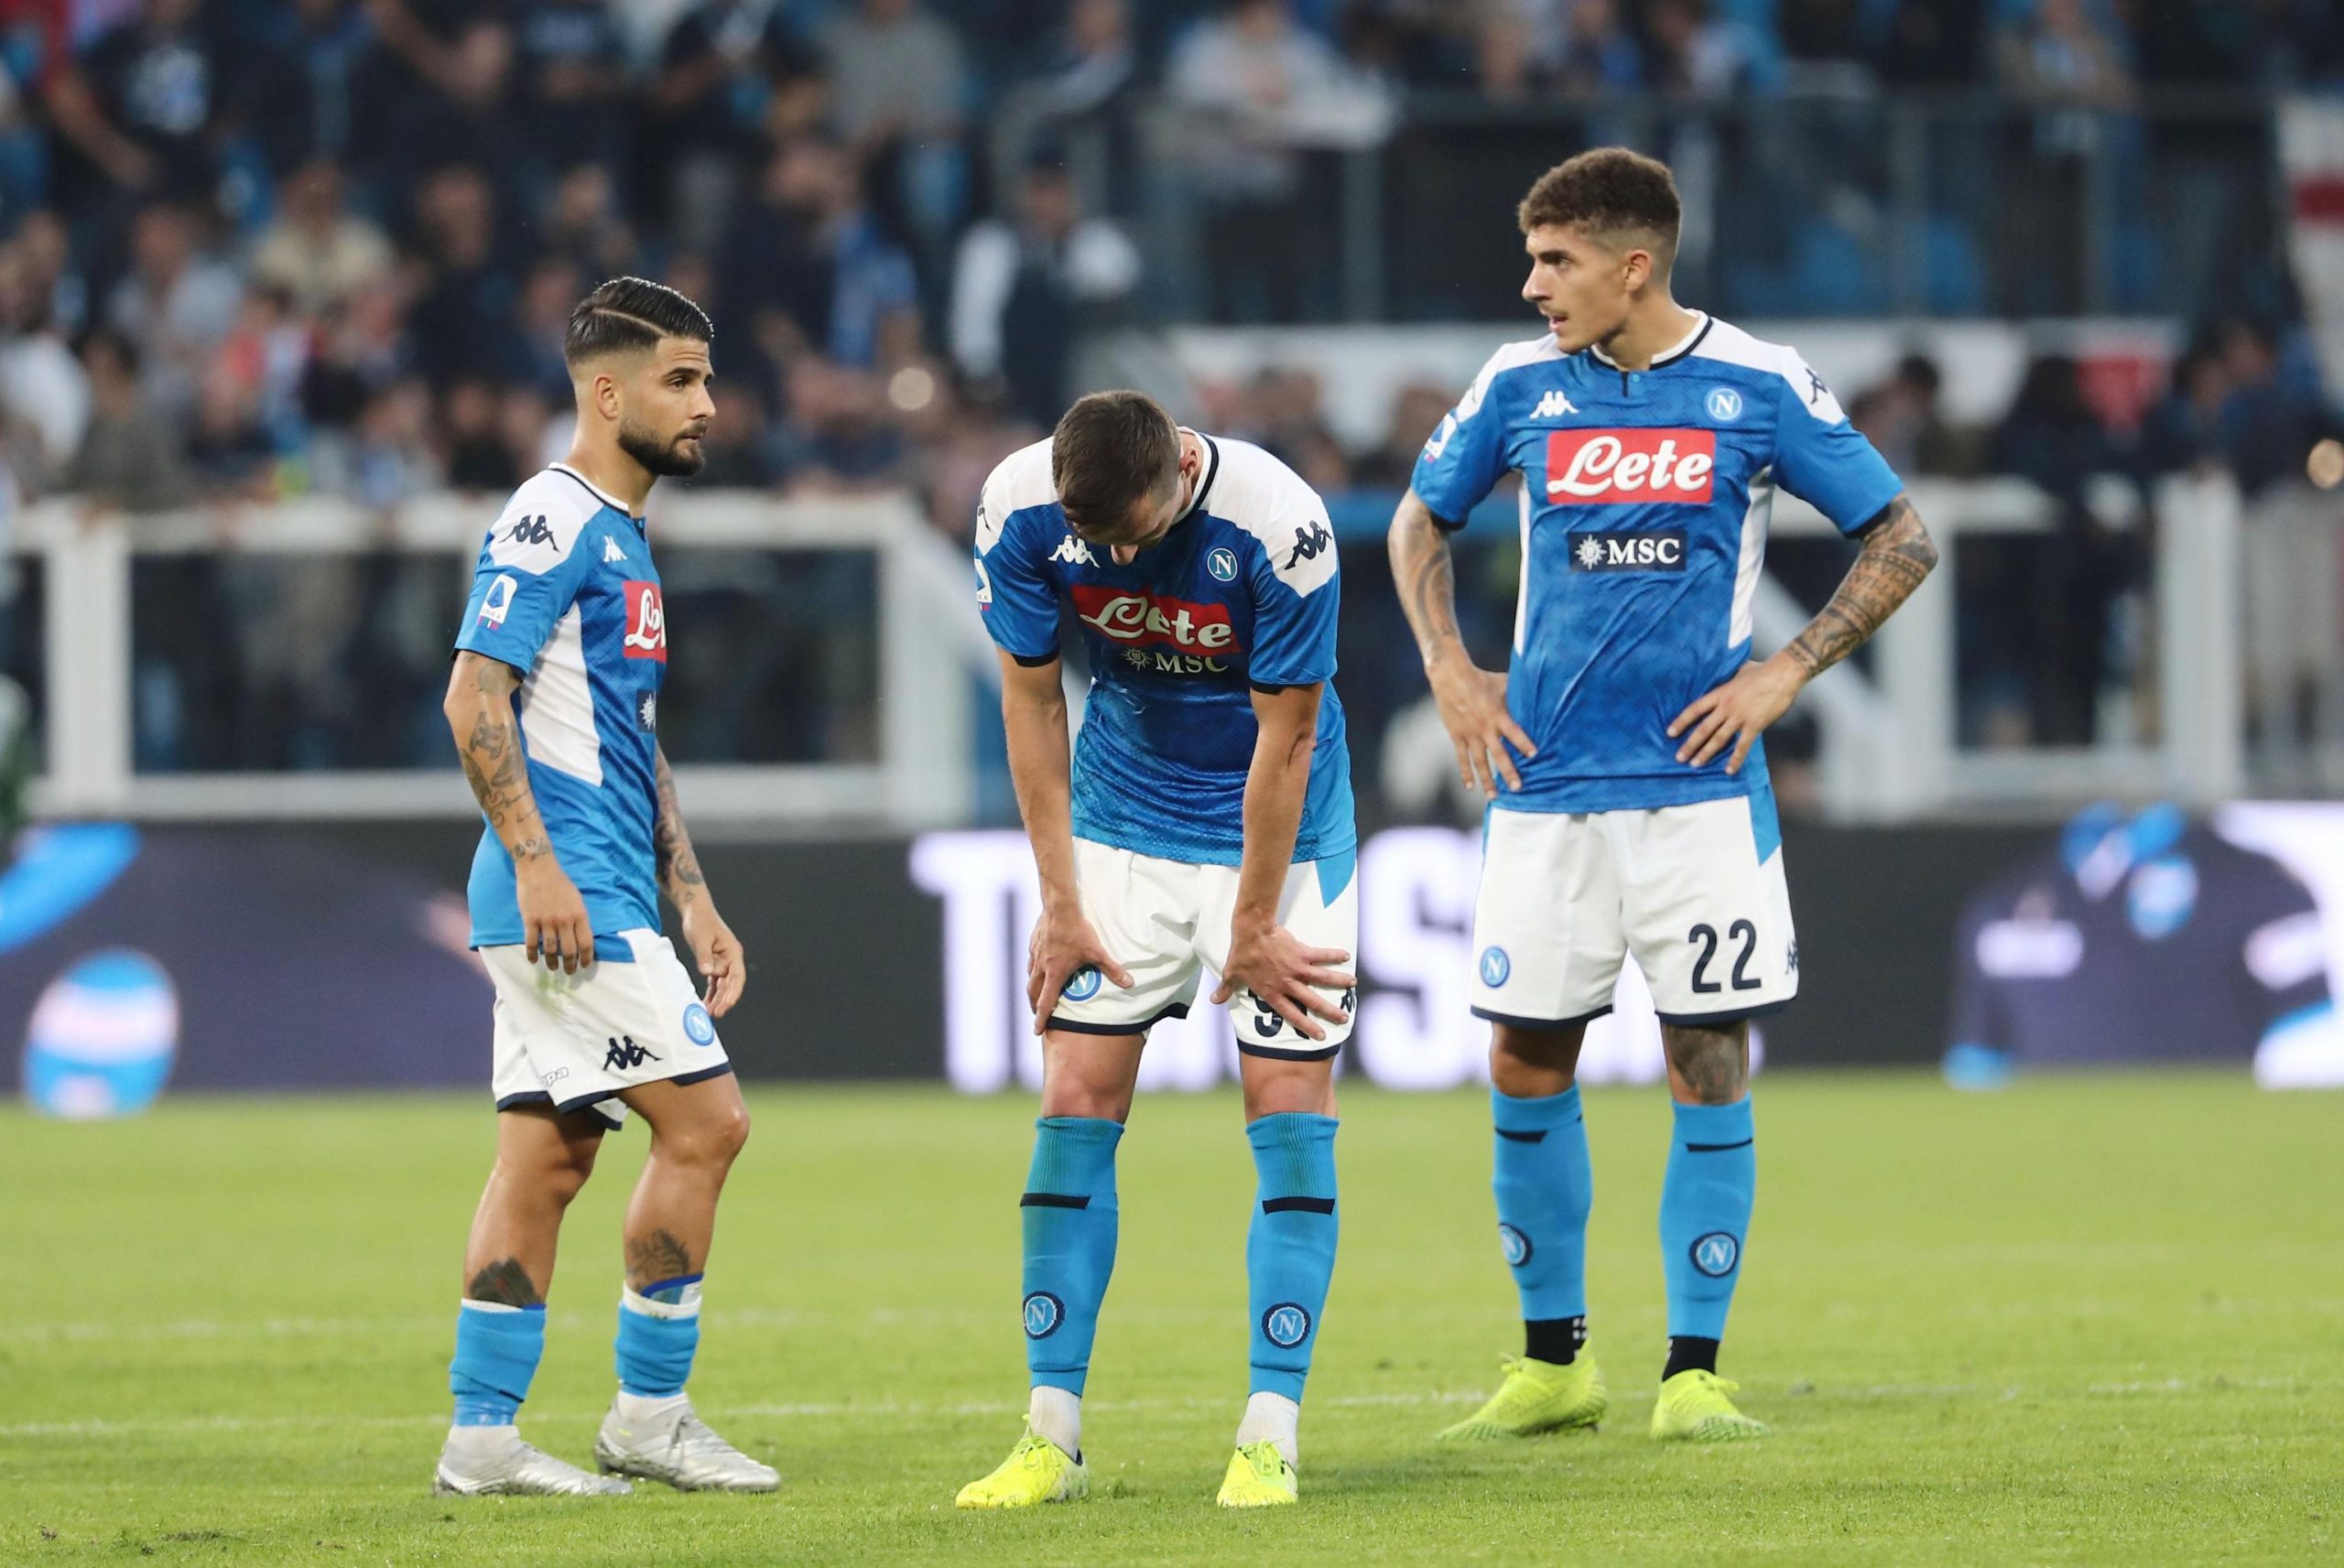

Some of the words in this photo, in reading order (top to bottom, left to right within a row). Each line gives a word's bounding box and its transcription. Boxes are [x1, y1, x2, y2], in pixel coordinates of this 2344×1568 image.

[1546, 436, 1712, 496] Lete
[1606, 538, 1681, 565] MSC
[1080, 596, 1233, 648] Lete
[1688, 918, 1762, 993] 22
